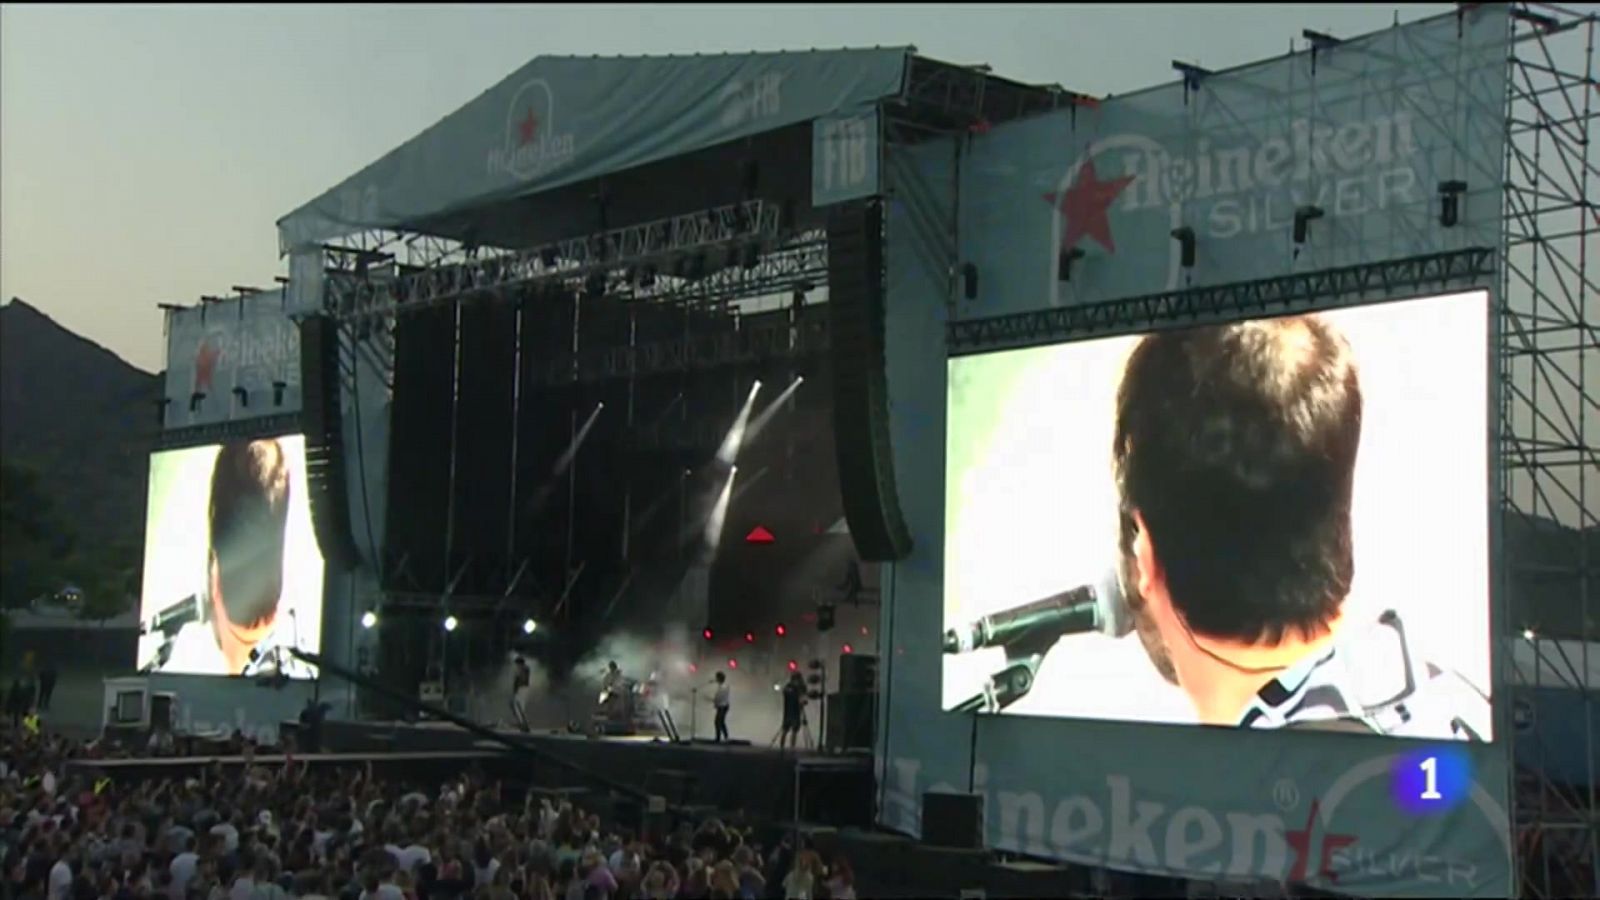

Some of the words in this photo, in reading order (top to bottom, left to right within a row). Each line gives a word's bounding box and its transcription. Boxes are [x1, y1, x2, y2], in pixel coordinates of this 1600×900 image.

[1121, 113, 1419, 211] Heineken
[1209, 166, 1416, 239] SILVER
[881, 757, 1291, 878] ineken
